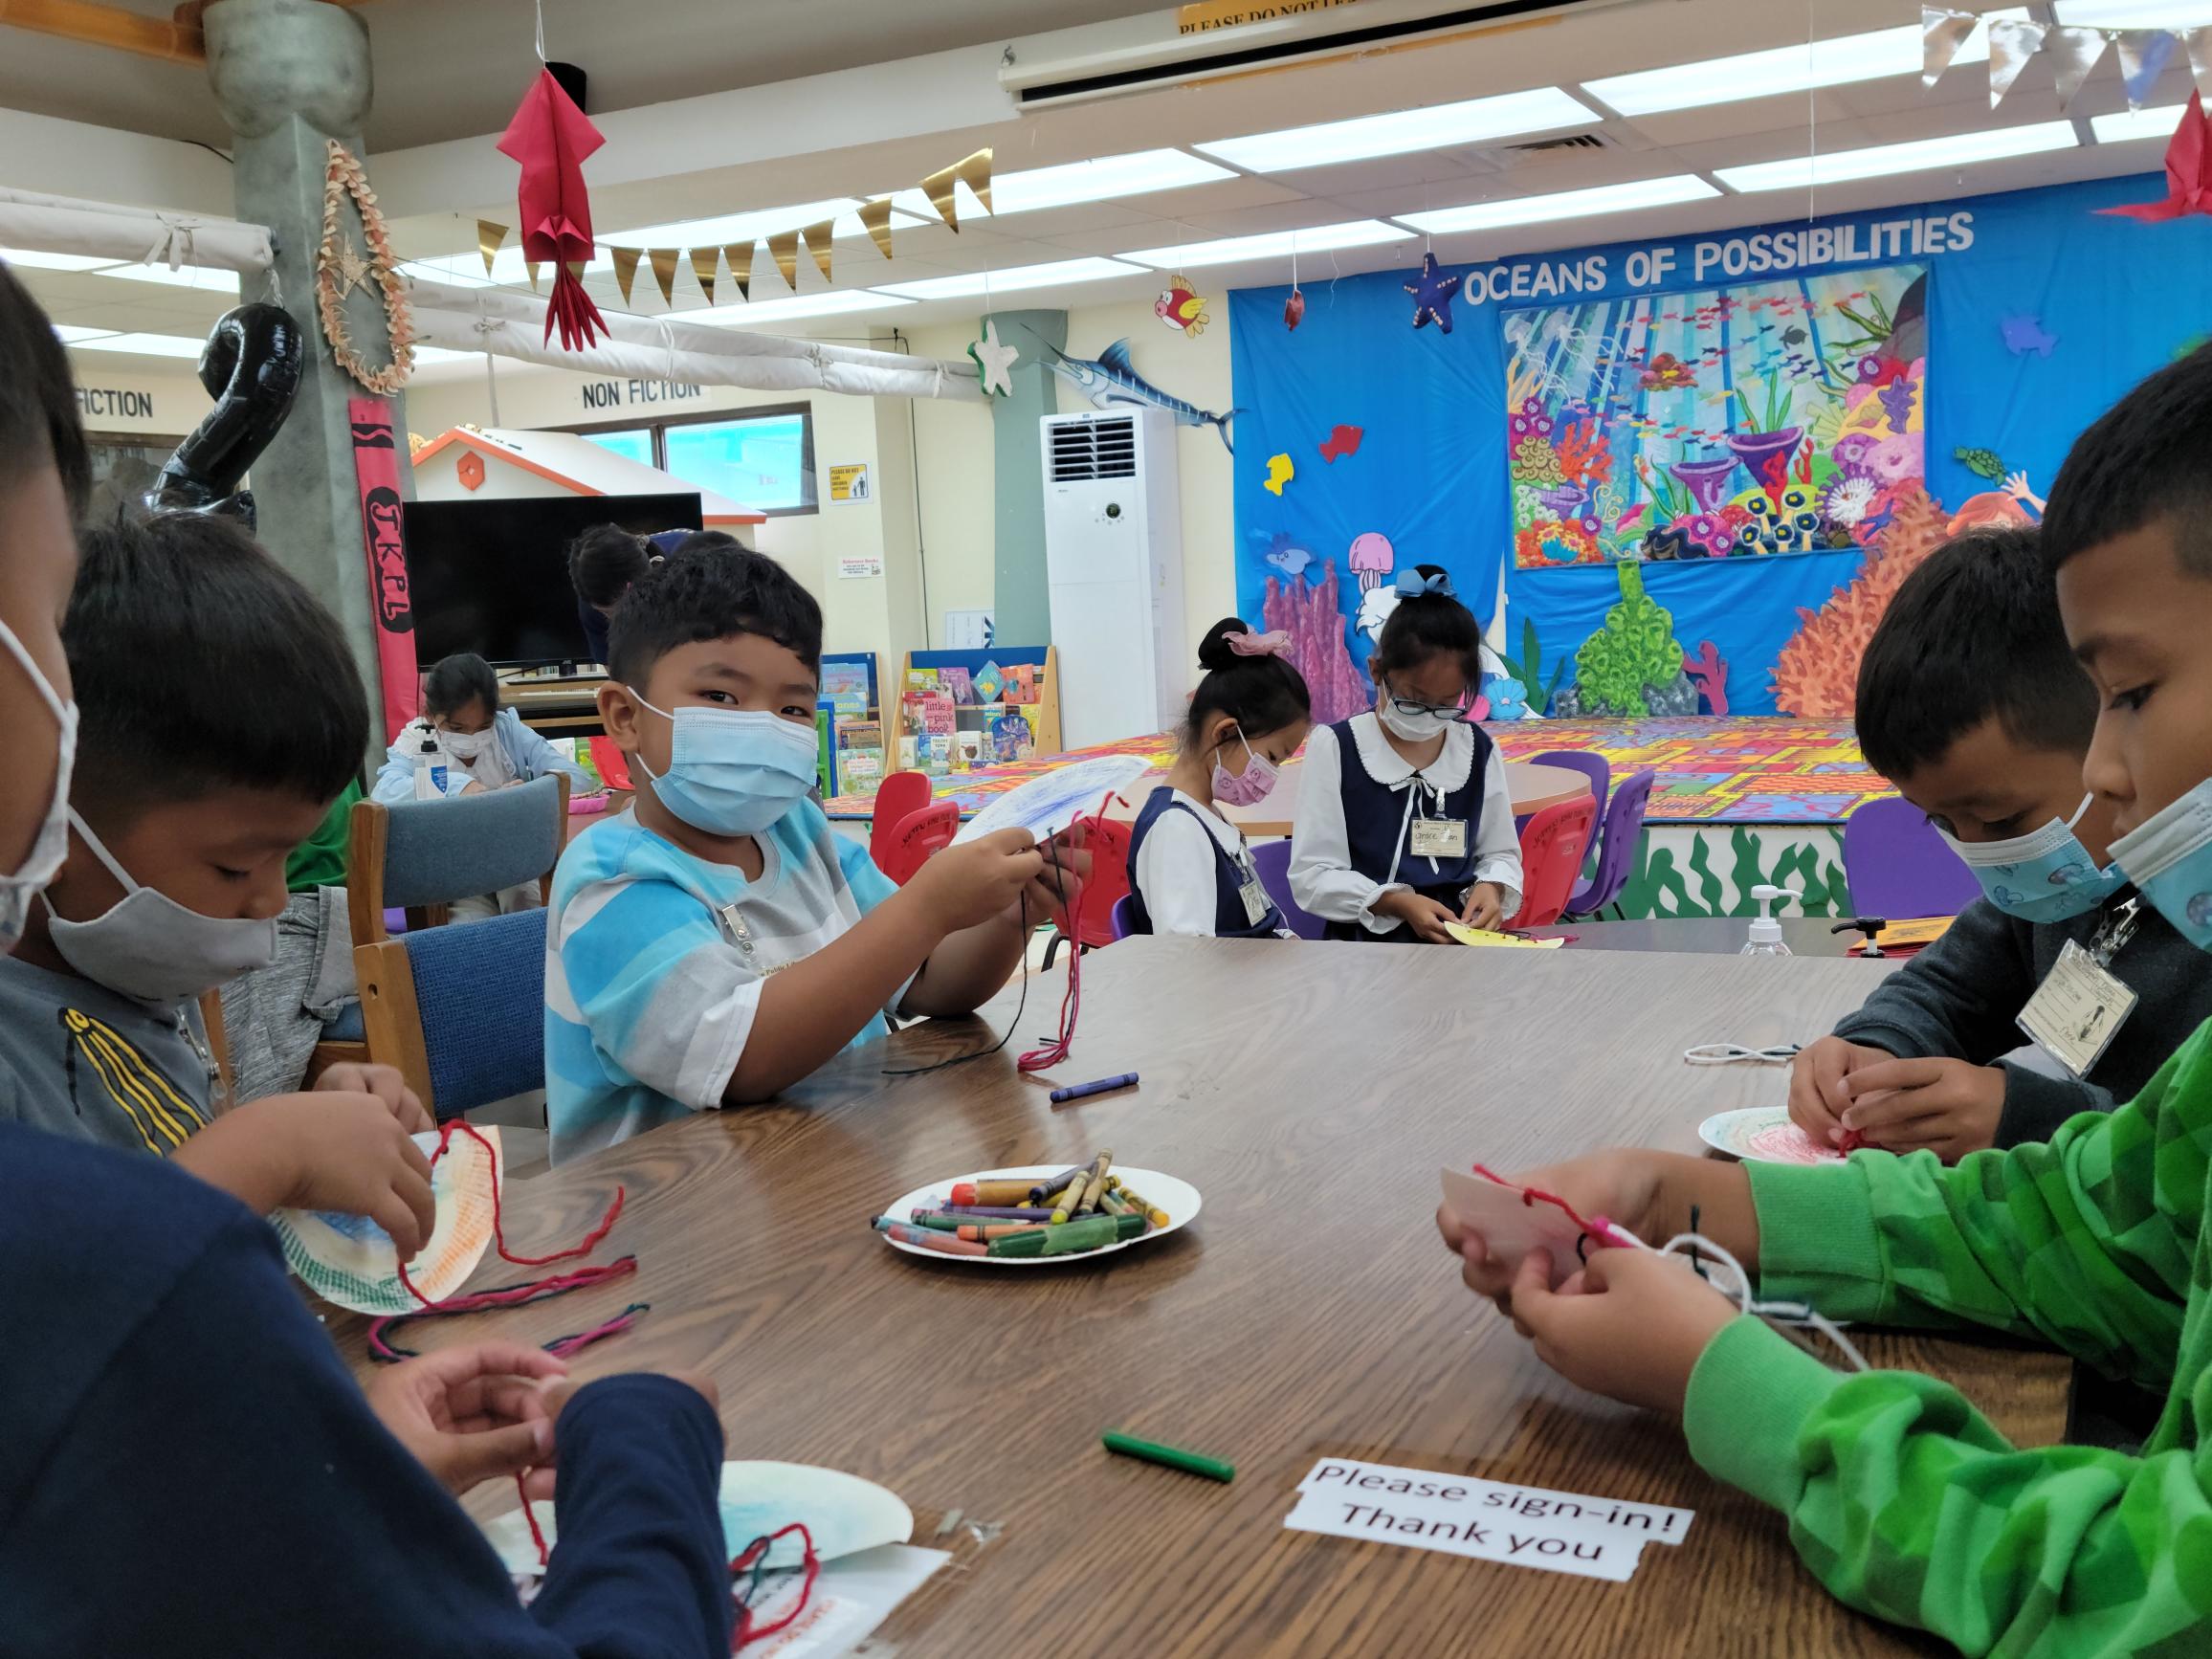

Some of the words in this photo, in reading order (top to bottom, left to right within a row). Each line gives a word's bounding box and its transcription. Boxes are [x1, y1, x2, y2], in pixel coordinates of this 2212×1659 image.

[1465, 255, 1607, 305] OCEANS
[1626, 248, 1676, 287] OF
[1694, 211, 1975, 281] POSSIBILITIES
[582, 381, 621, 409] NON
[370, 501, 409, 619] JKPL
[926, 701, 946, 711] little
[934, 714, 953, 725] pink
[927, 722, 949, 734] book
[1483, 1486, 1676, 1535] sign-in!
[1340, 1501, 1494, 1545] Thank
[1506, 1531, 1604, 1563] you
